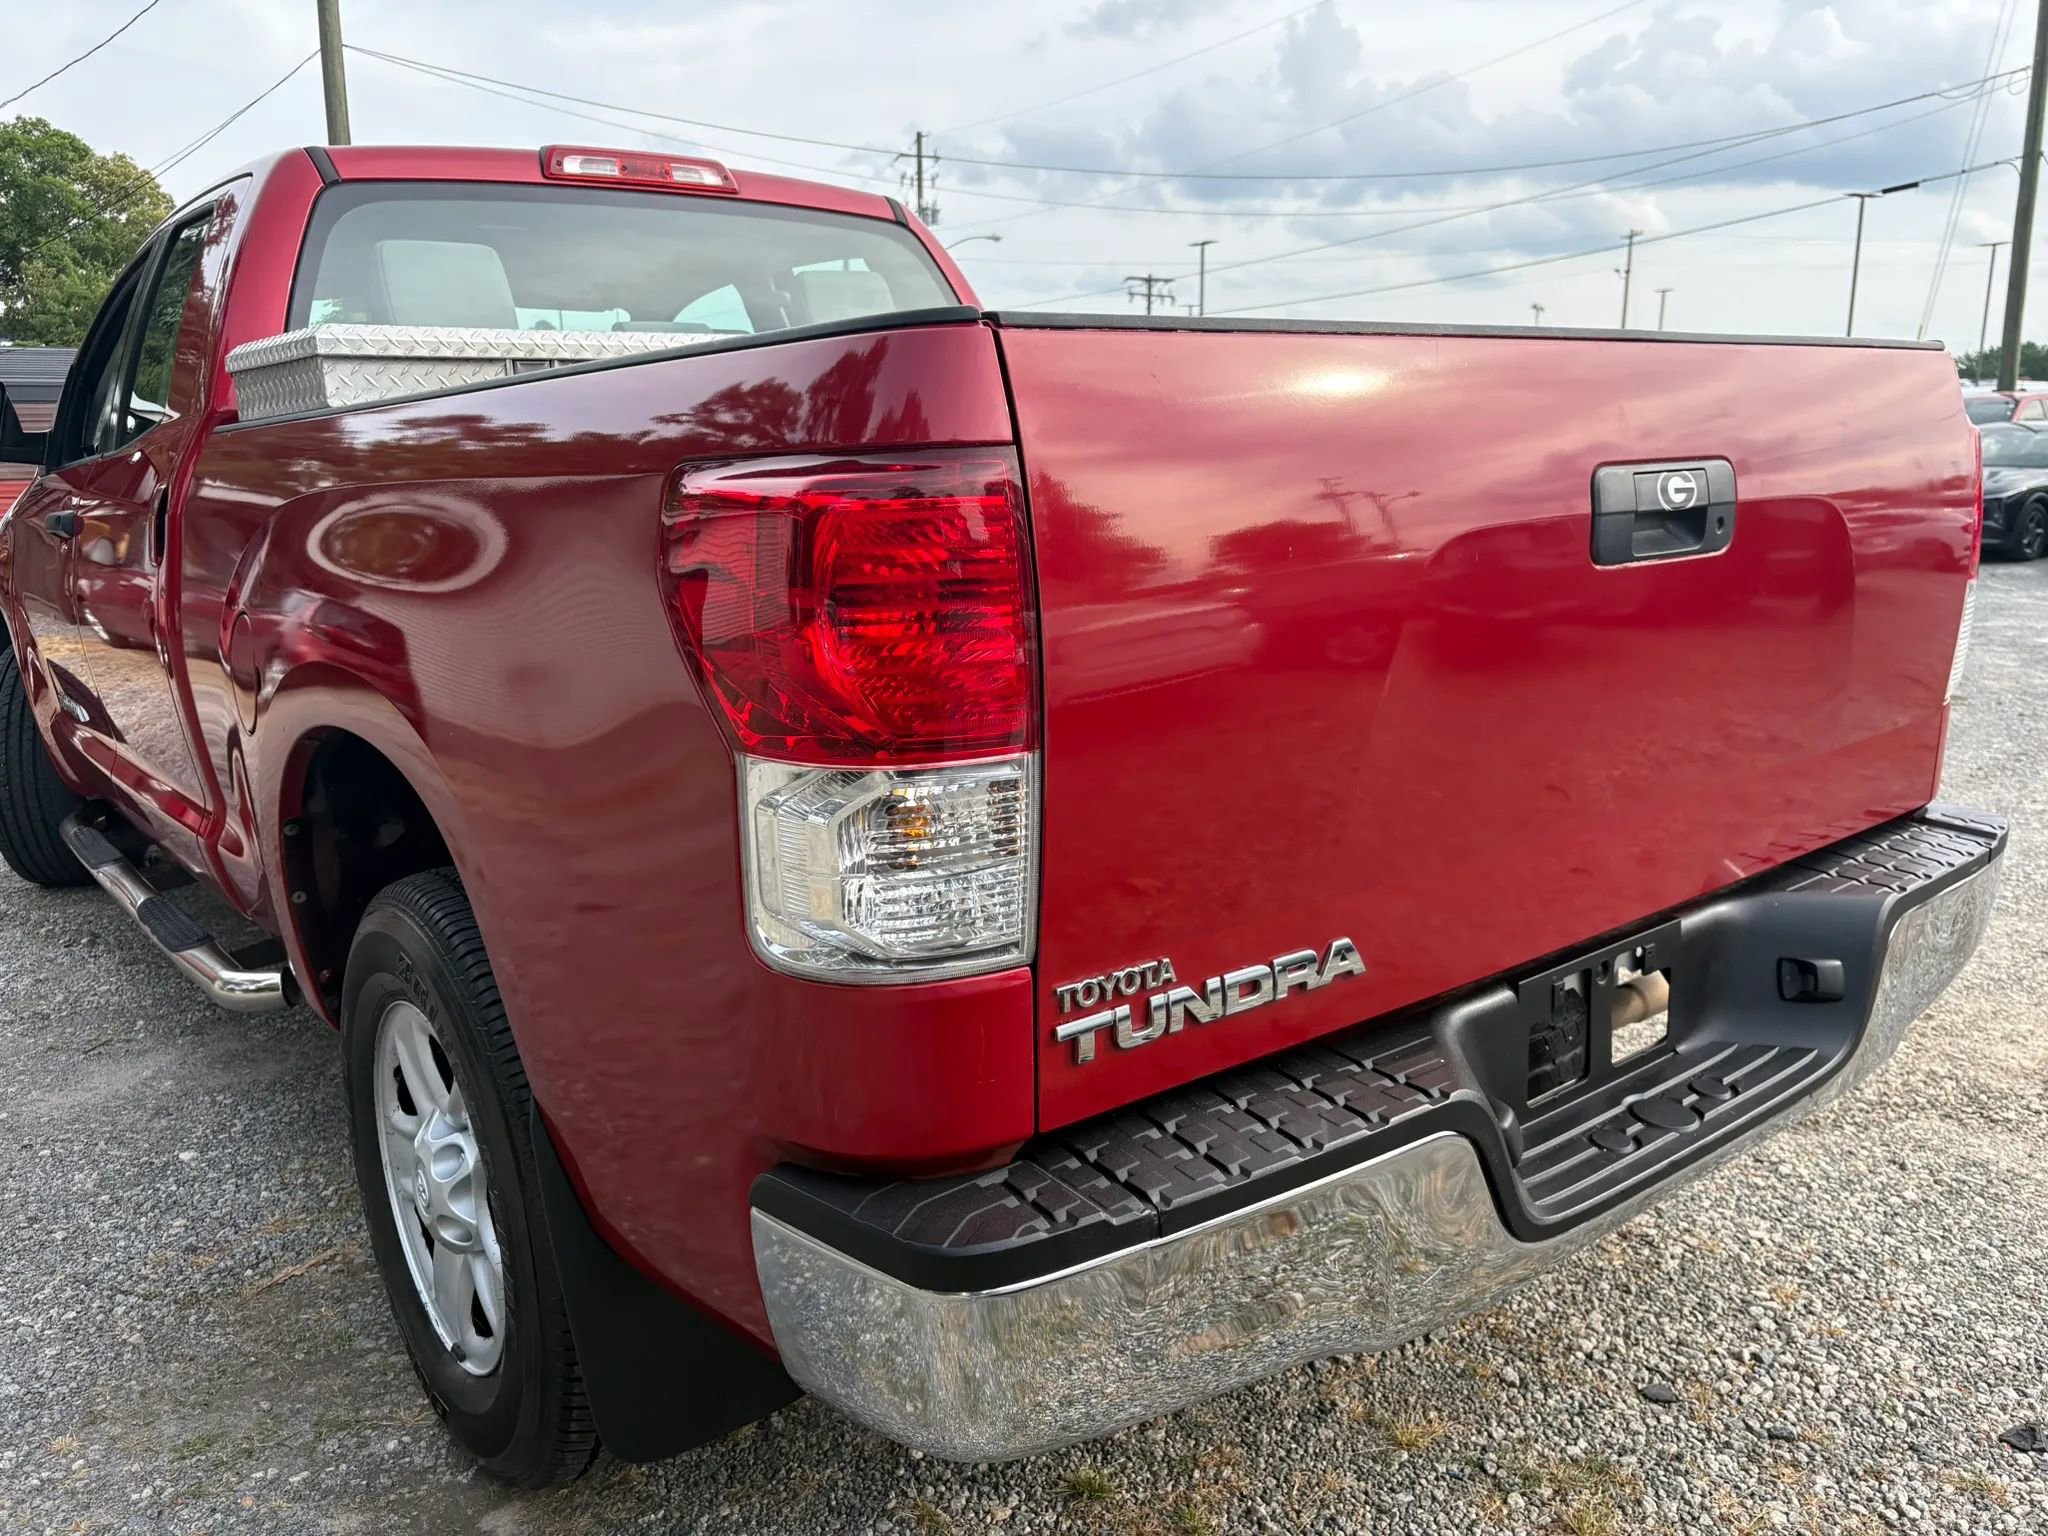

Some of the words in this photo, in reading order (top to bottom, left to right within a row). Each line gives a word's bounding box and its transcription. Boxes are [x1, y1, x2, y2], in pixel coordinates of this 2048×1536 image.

[1657, 471, 1698, 511] G
[1055, 957, 1178, 1013] TOYOTA
[1055, 937, 1367, 1065] TUNDRA
